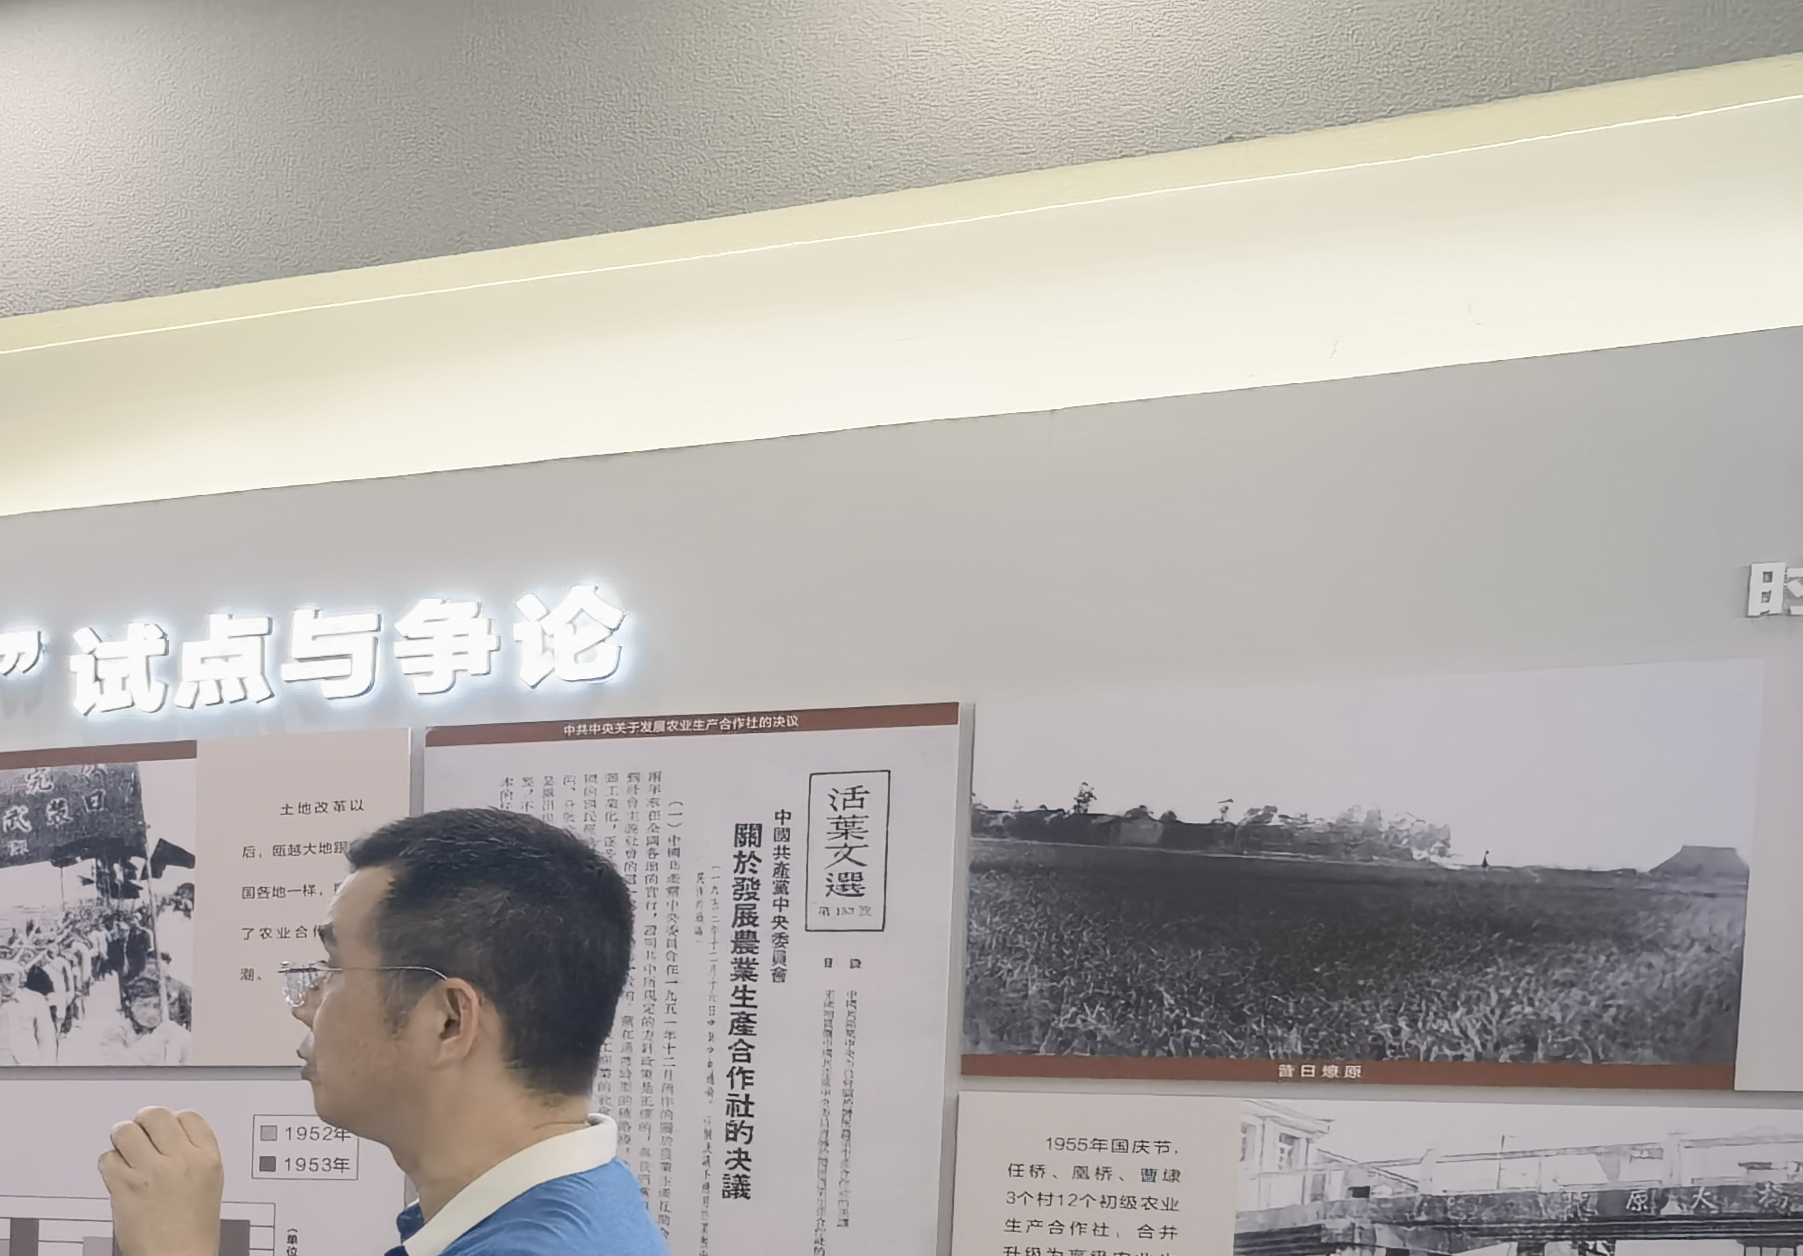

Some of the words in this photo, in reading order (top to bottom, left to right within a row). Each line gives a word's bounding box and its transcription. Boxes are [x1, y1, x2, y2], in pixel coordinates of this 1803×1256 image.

[279, 799, 365, 816] 土地改革以
[242, 883, 341, 900] 国各地一样，
[284, 1126, 352, 1142] 1952年
[283, 1157, 351, 1173] 1953年
